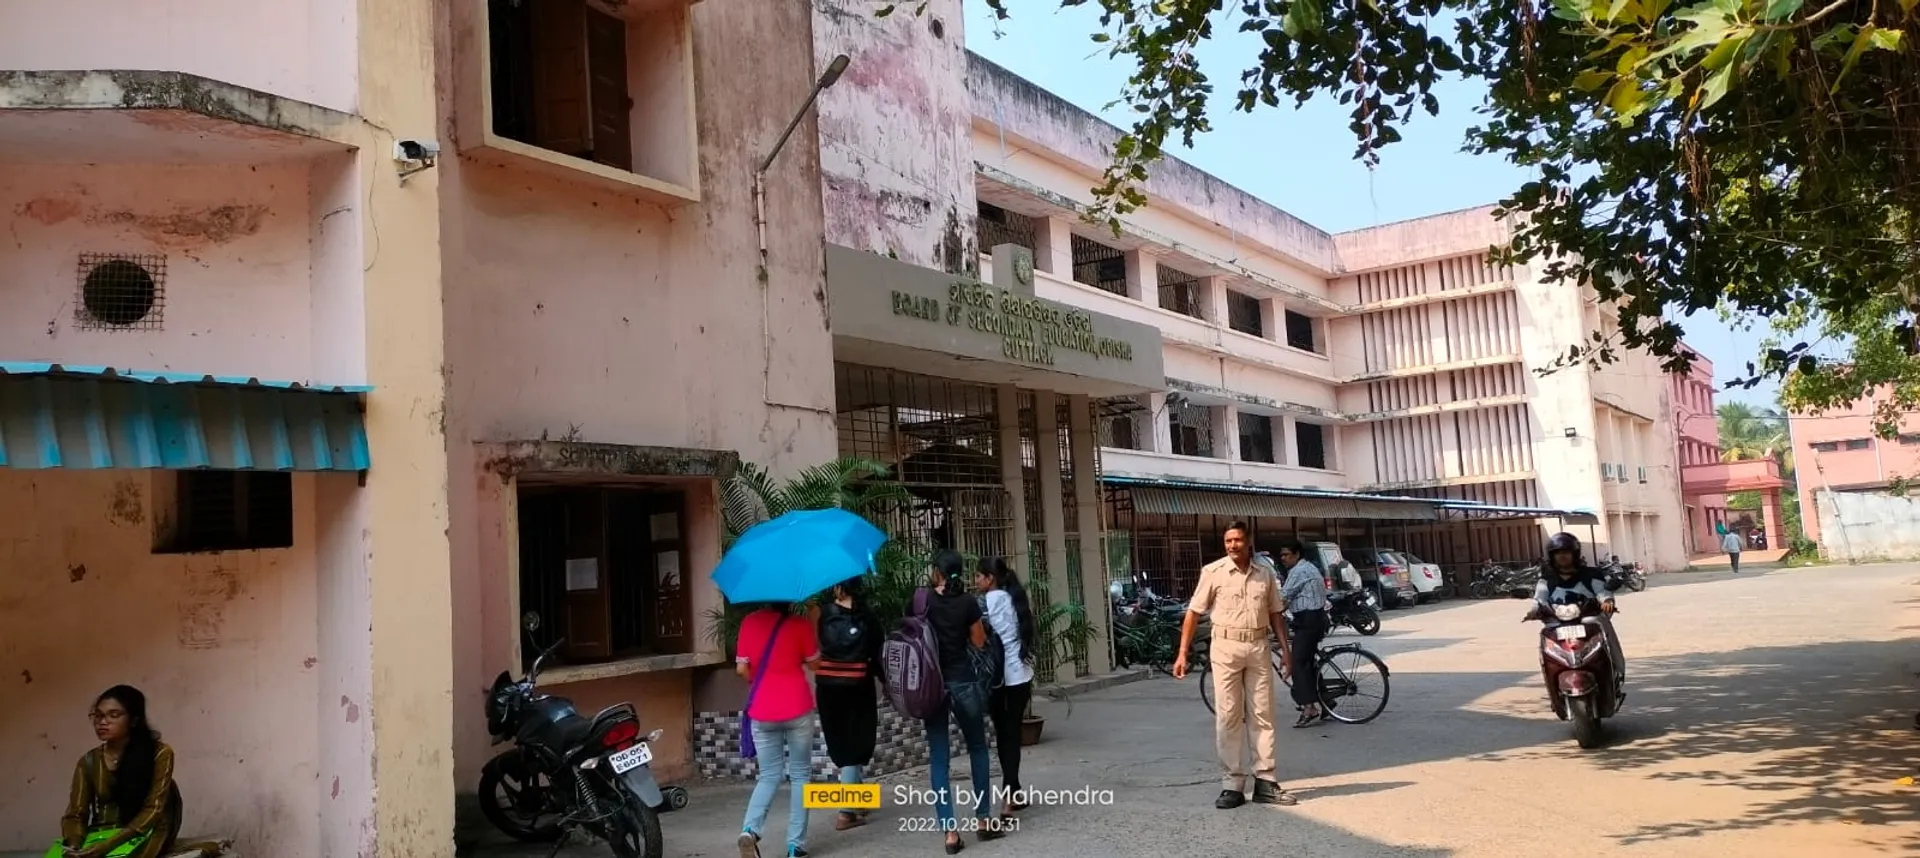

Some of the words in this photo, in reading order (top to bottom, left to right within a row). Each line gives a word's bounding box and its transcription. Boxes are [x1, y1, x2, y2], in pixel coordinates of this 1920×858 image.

[891, 290, 940, 322] BOARD
[946, 302, 961, 327] OF
[967, 308, 1034, 342] SECONDARY
[1002, 337, 1055, 366] CUTTACK
